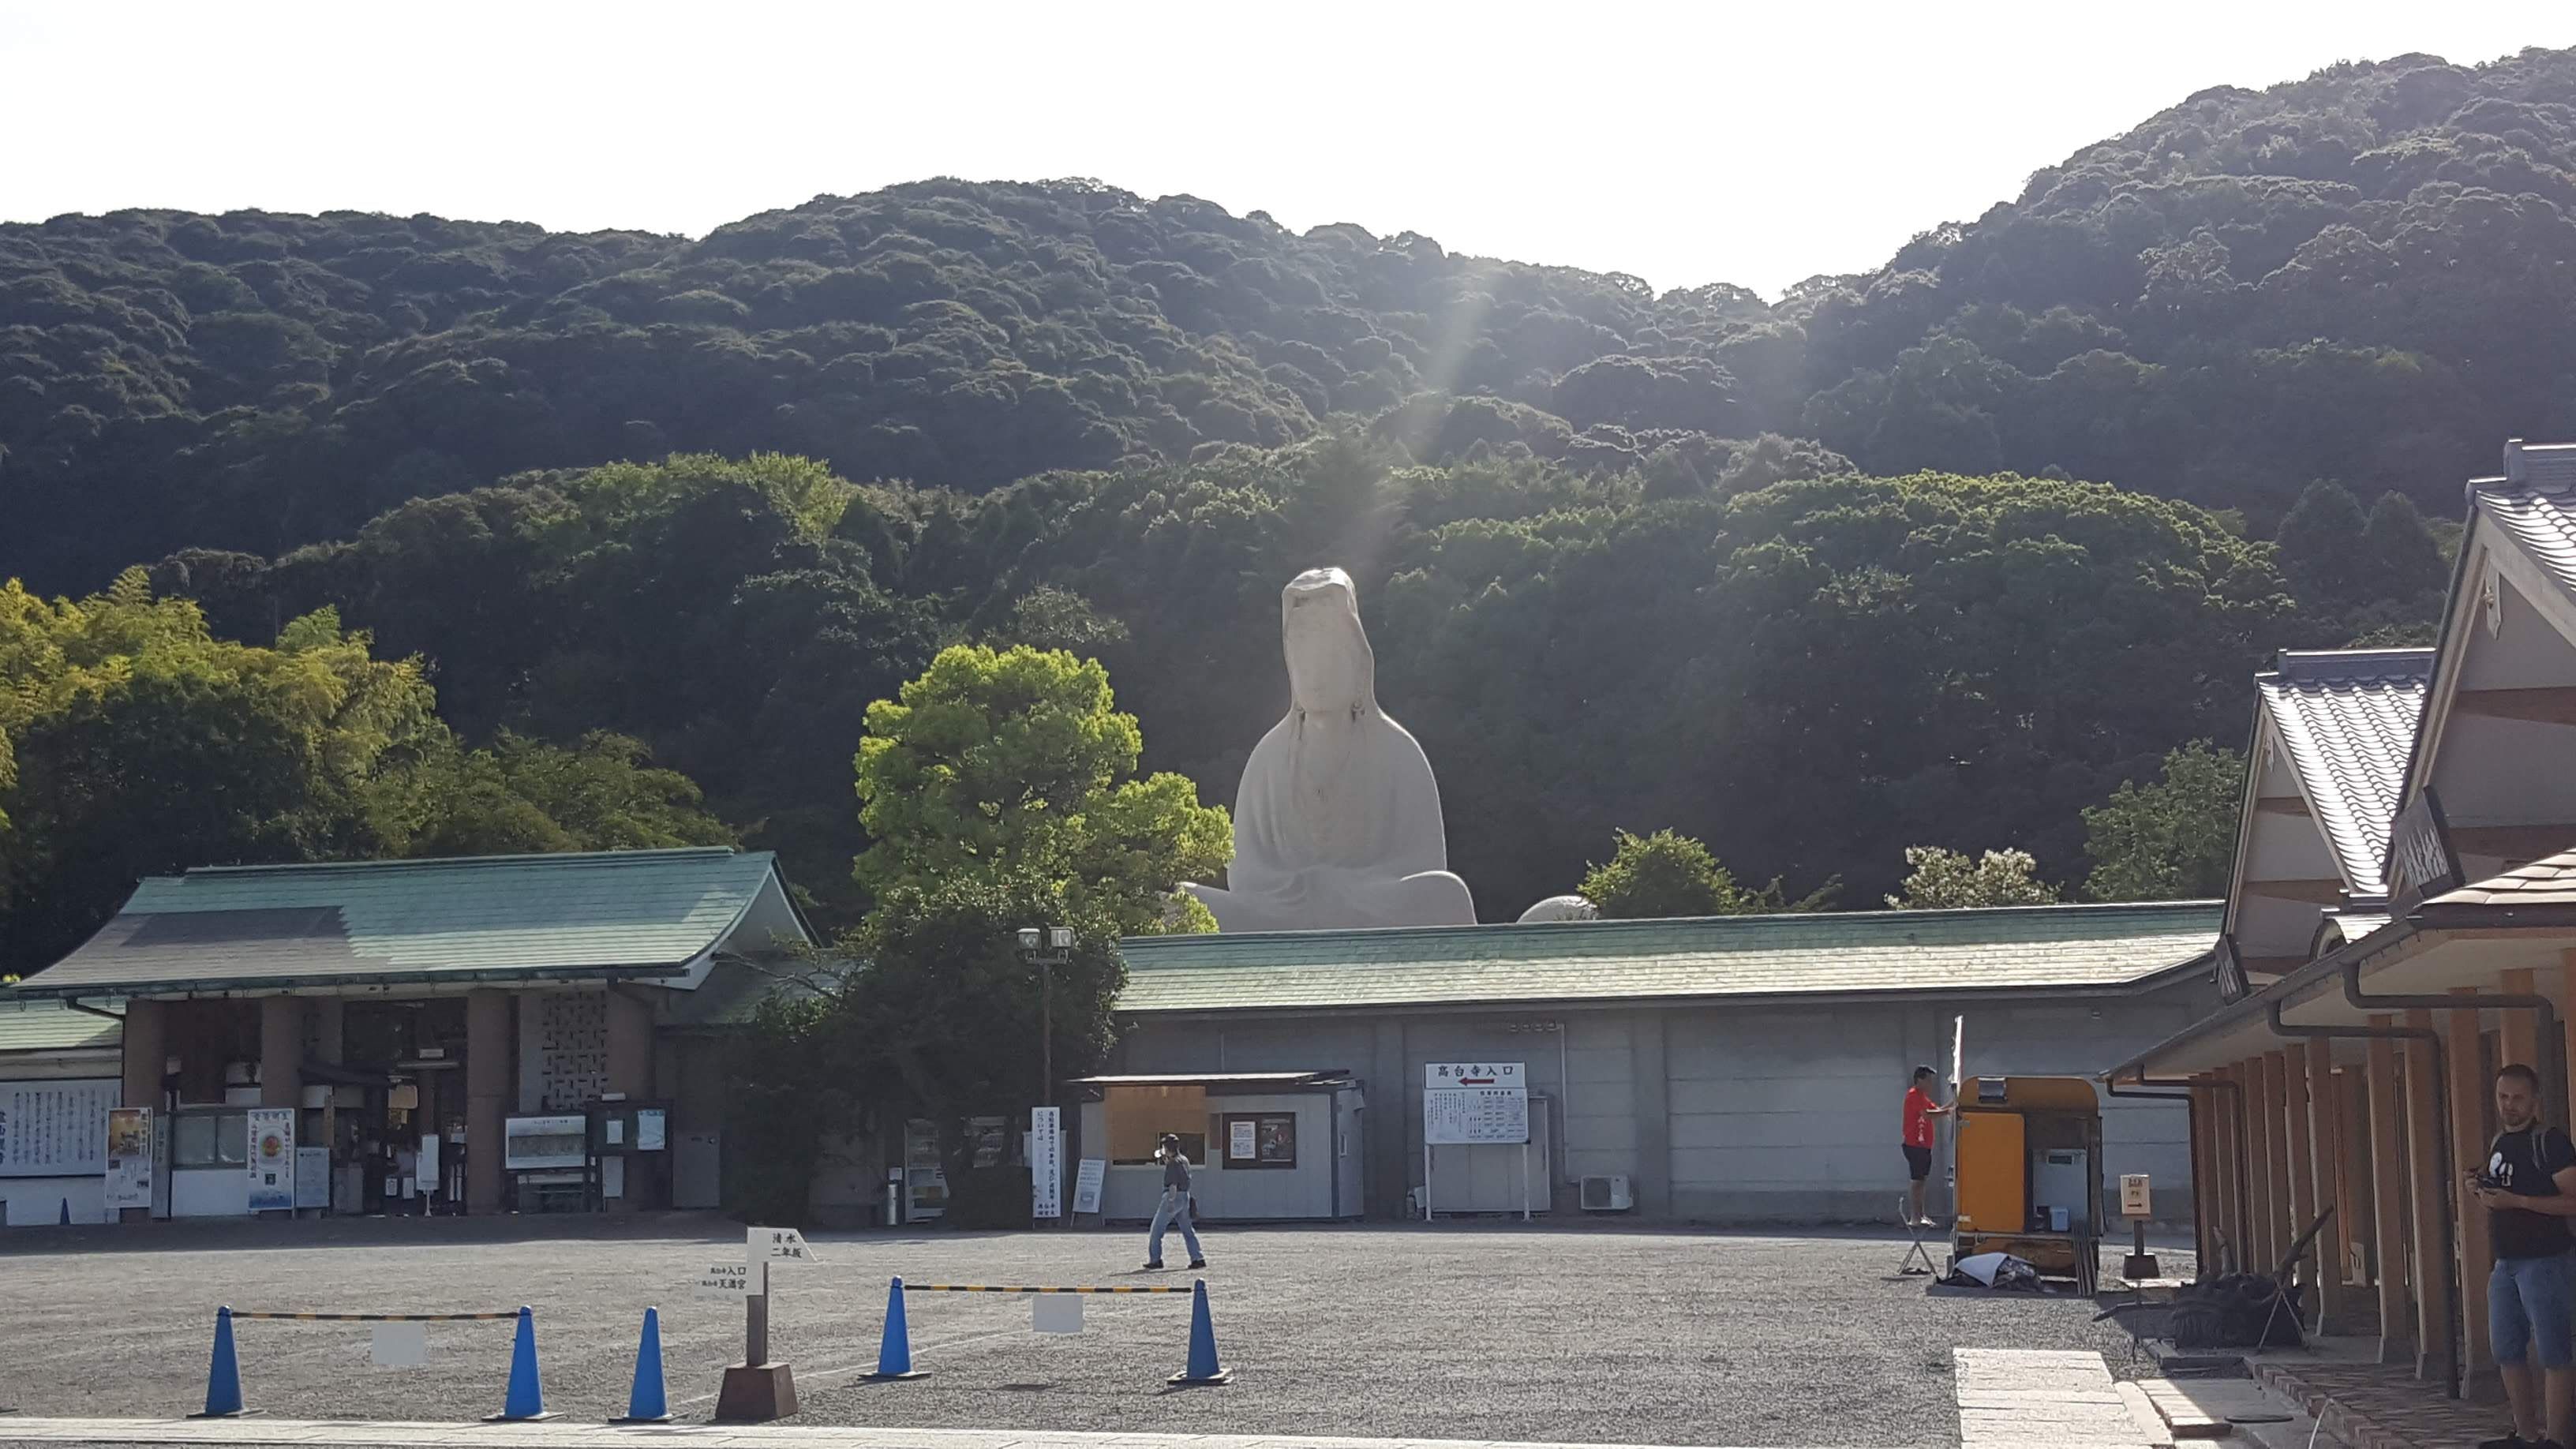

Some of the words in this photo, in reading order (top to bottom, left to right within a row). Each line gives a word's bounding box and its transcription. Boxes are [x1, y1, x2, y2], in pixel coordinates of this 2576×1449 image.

[1438, 1065, 1514, 1077] 高台寺入口
[772, 1233, 797, 1244] 清水
